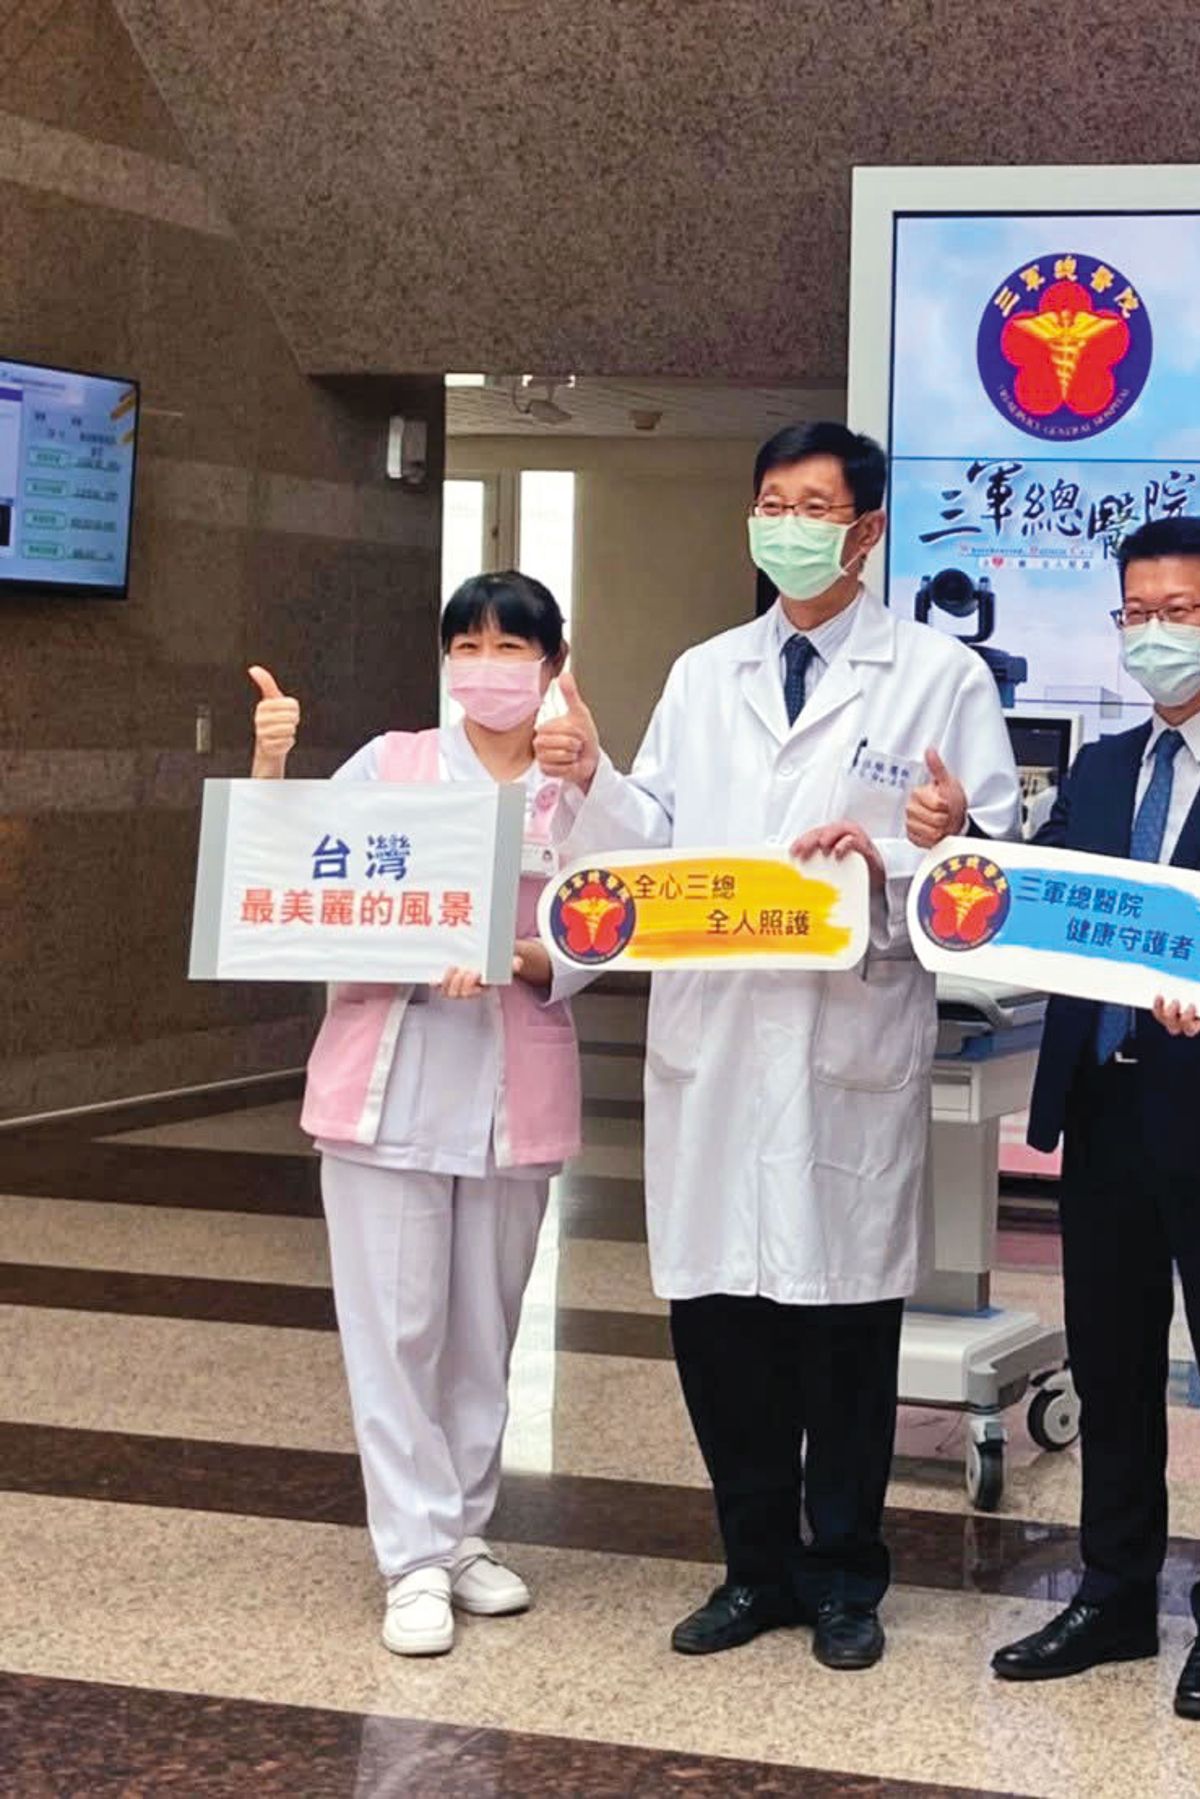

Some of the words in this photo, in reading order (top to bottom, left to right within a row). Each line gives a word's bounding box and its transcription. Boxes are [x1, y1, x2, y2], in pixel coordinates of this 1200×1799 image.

[312, 834, 411, 881] 台灣
[240, 888, 473, 928] 最美麗的風景
[633, 874, 735, 901] 全心三總
[1015, 875, 1145, 919] 三軍總醫院
[706, 909, 810, 936] 全人照護
[1066, 916, 1195, 961] 健康守護者
